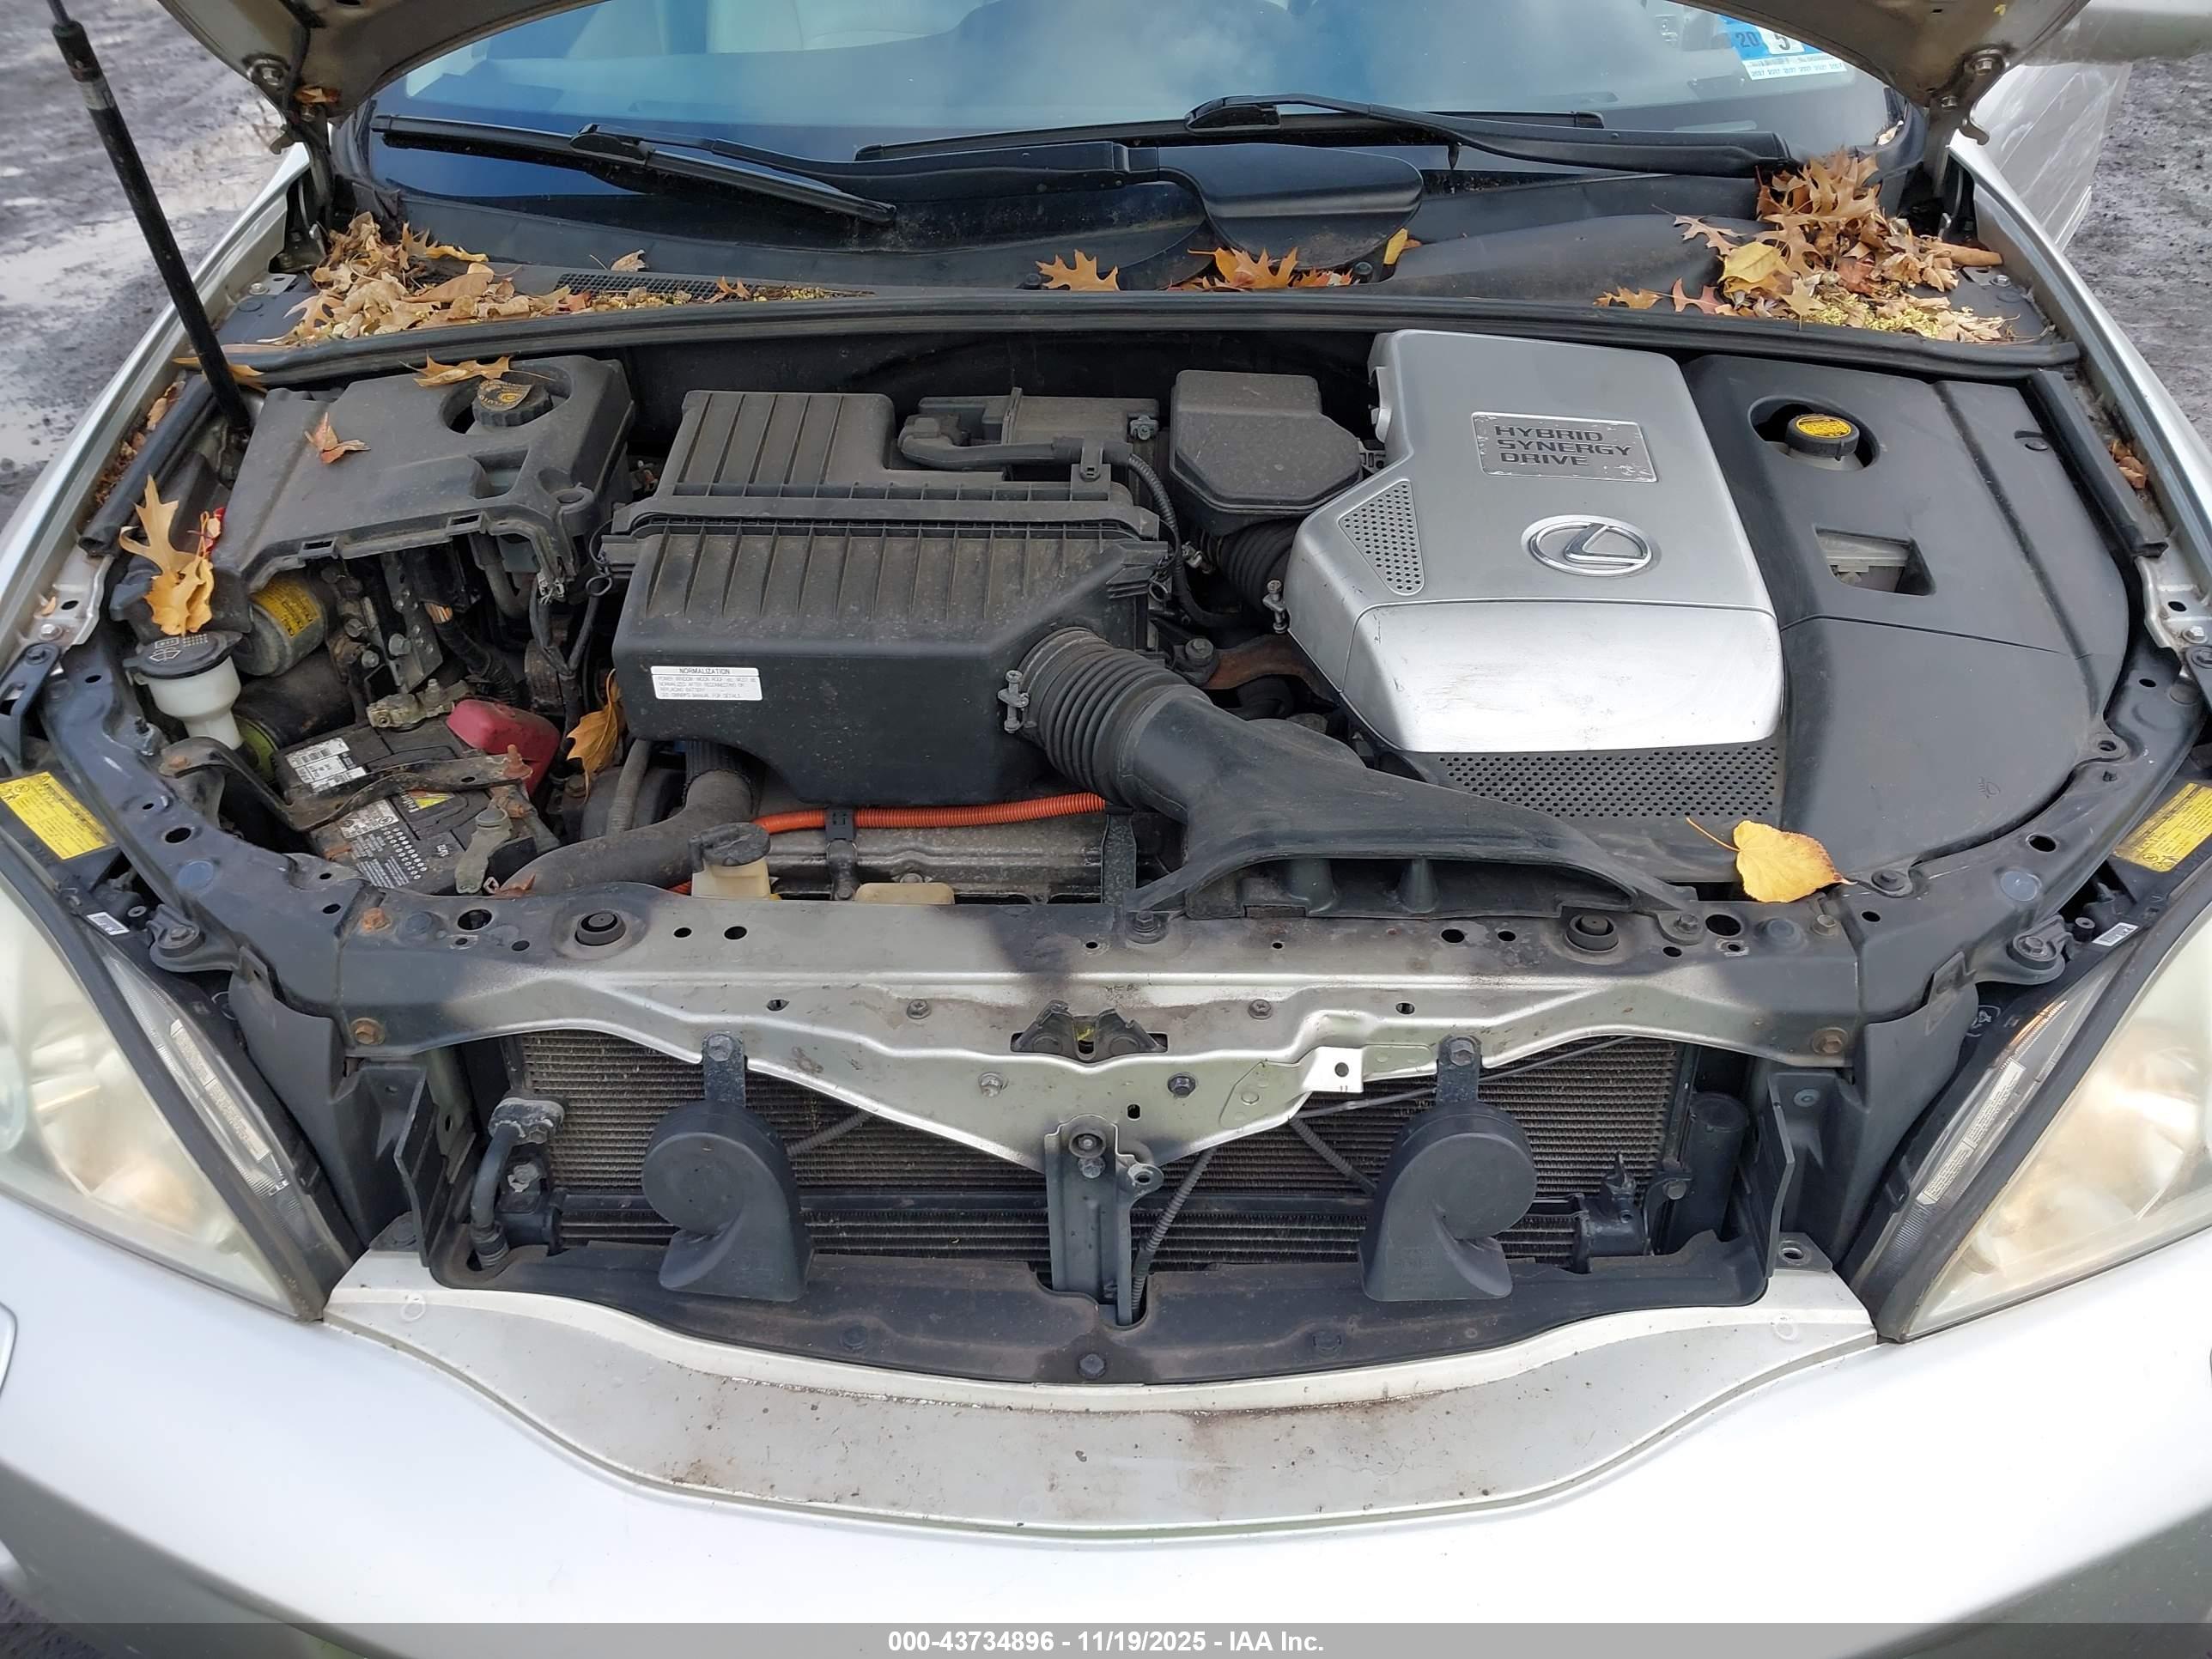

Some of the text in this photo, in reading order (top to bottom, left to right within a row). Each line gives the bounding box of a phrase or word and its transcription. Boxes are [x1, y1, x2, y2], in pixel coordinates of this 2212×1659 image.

[1495, 425, 1603, 441] HYBRID
[1497, 439, 1632, 456] SYNERGY
[1500, 452, 1589, 466] DRIVE
